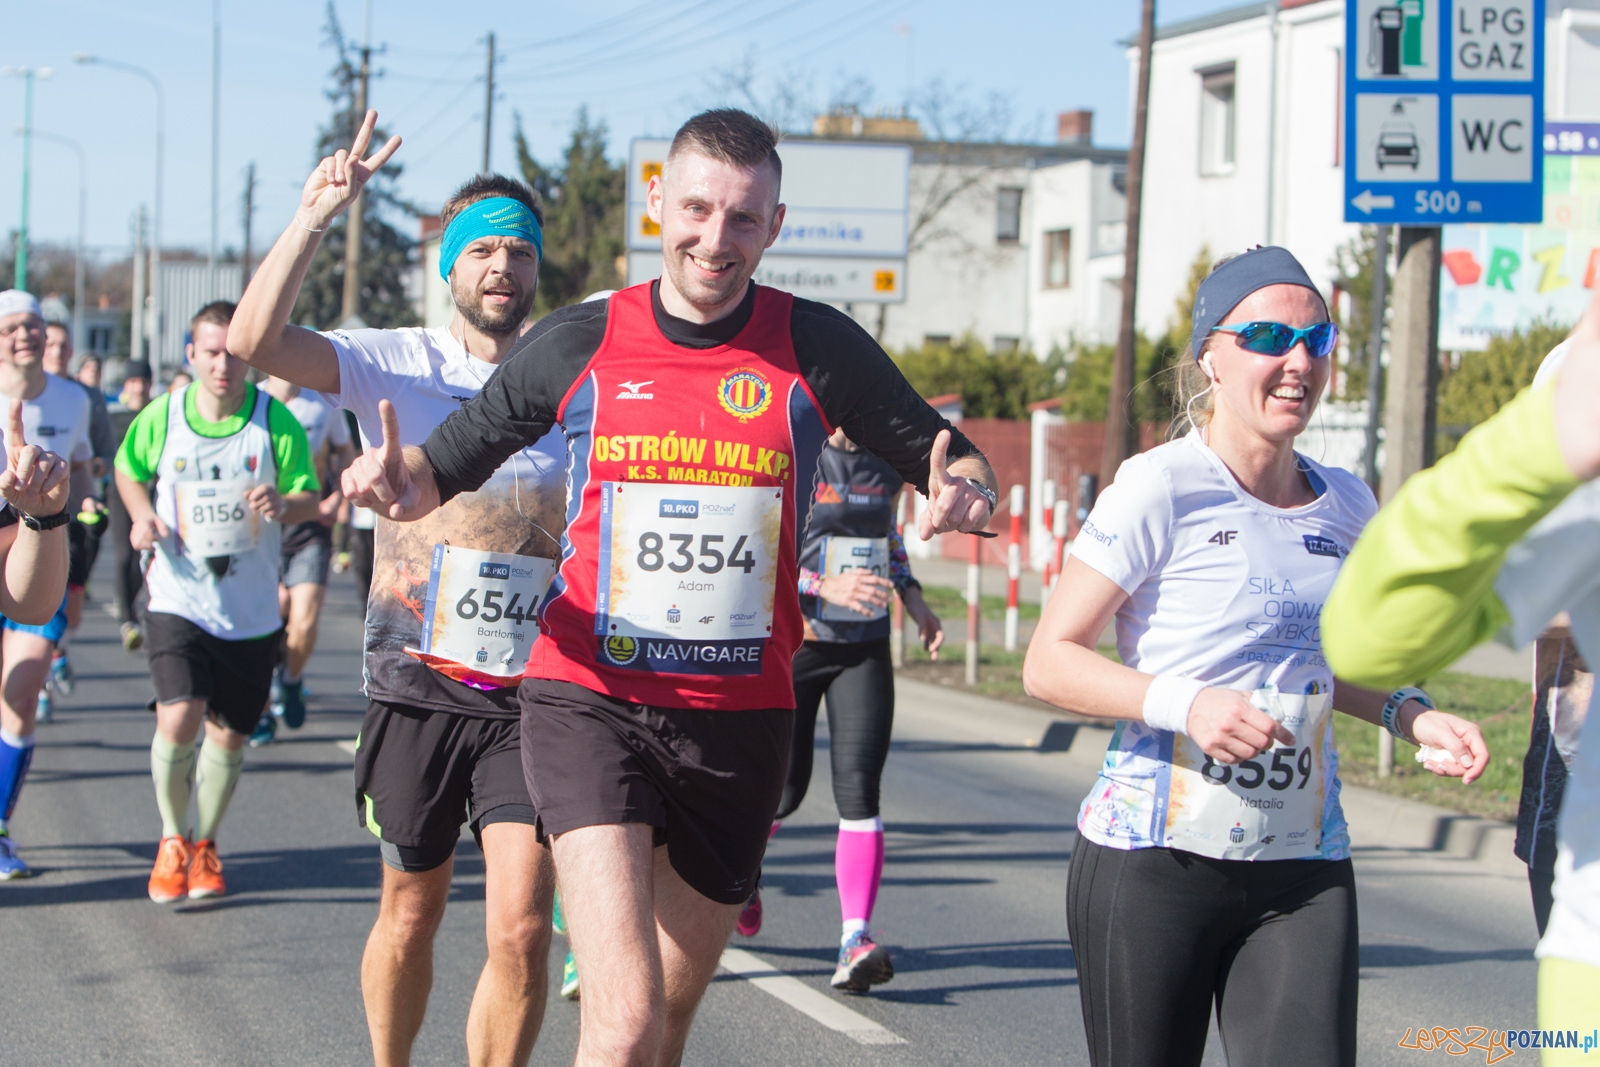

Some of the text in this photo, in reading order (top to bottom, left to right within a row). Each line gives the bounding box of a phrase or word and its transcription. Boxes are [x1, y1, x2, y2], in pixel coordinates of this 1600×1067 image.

[1459, 8, 1525, 35] LPG
[1459, 42, 1525, 70] GAZ
[1461, 120, 1523, 153] WC
[1415, 190, 1482, 213] 500 m
[781, 222, 863, 243] pernika
[726, 374, 764, 390] MARATON
[595, 430, 789, 480] OSTRÓW WLKP.
[627, 465, 753, 486] K.S. MARATON
[192, 502, 245, 524] 8156
[1208, 530, 1239, 546] 4F
[636, 531, 756, 575] 8354
[677, 580, 715, 592] Adam
[1249, 577, 1296, 596] SIŁA
[455, 588, 539, 627] 6544
[477, 627, 525, 642] Bartłomiej
[647, 642, 761, 662] NAVIGARE
[1201, 746, 1312, 791] 8559
[1239, 796, 1284, 810] Natalia
